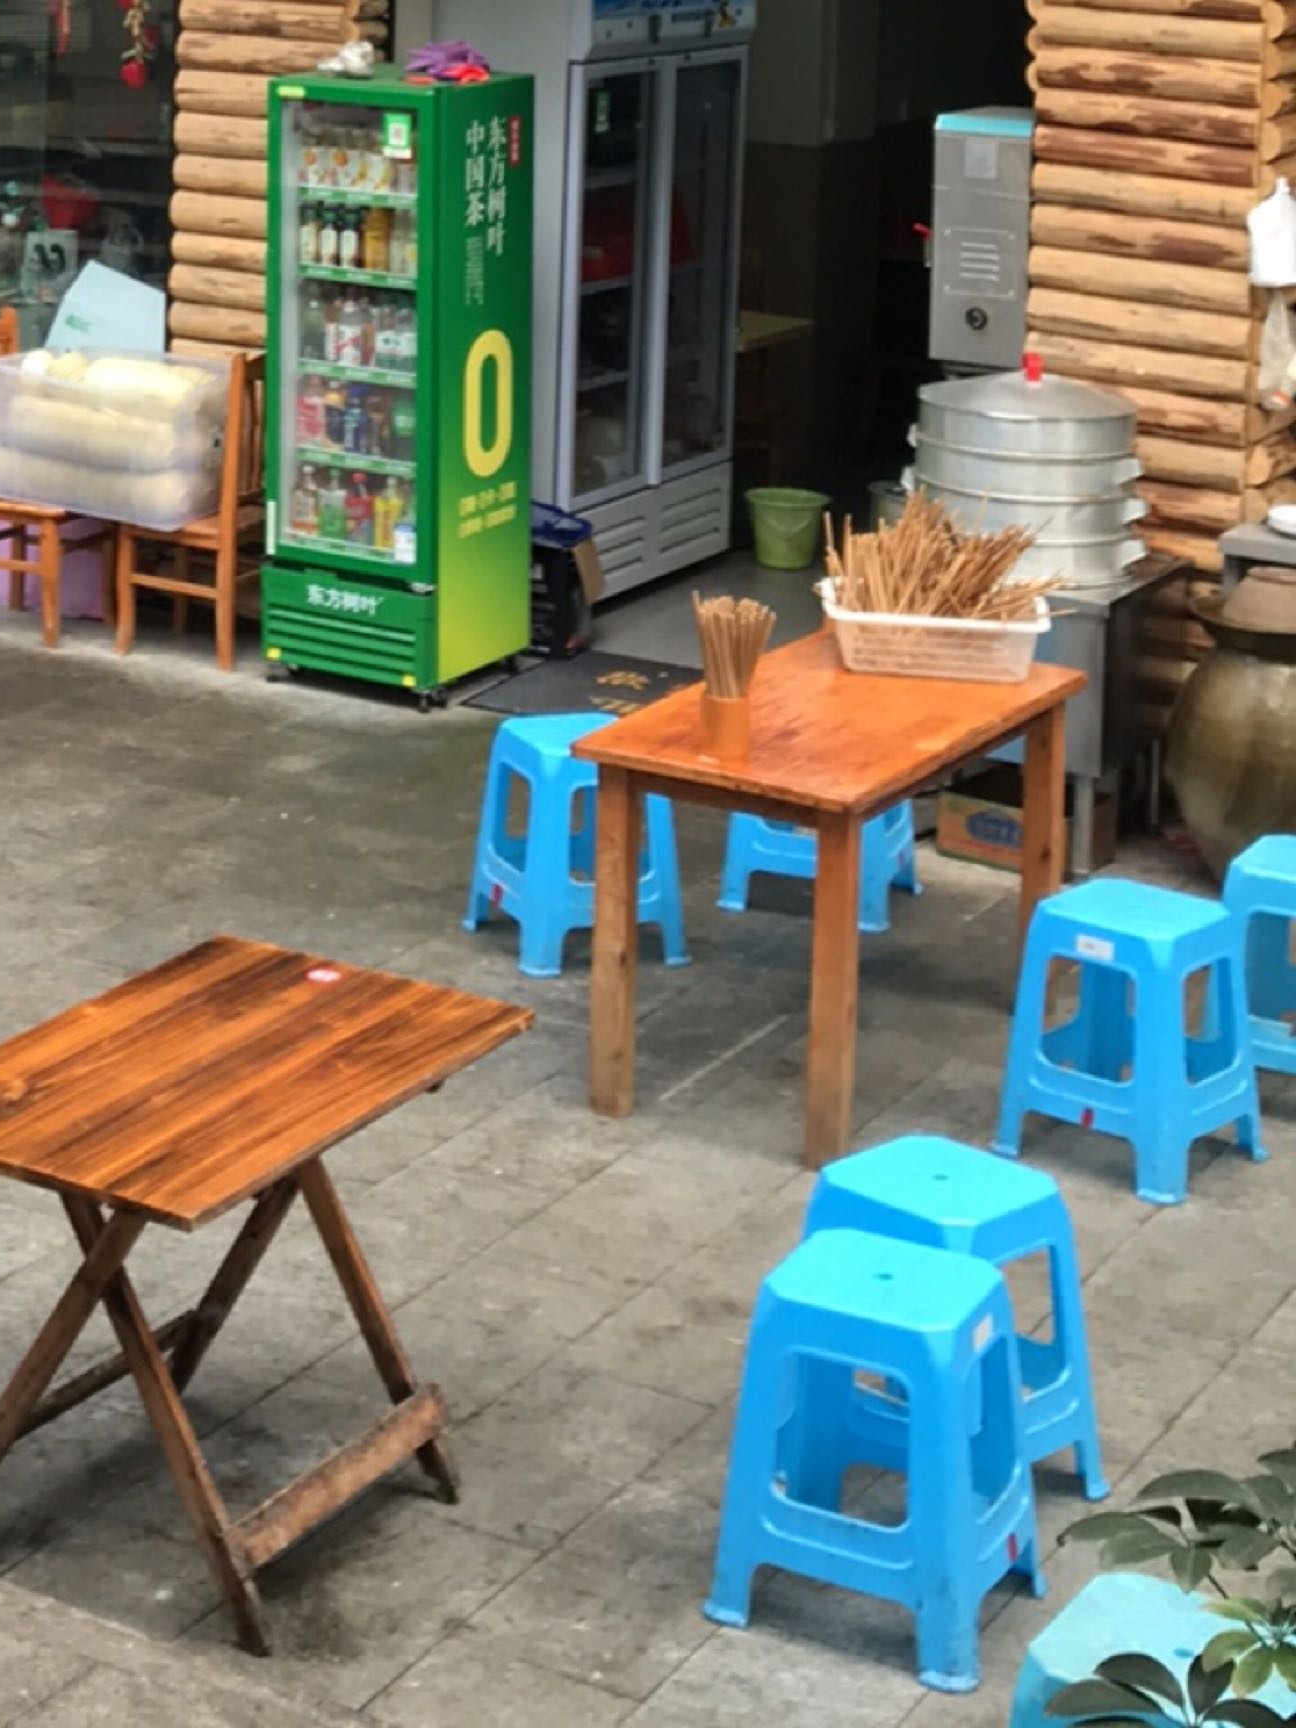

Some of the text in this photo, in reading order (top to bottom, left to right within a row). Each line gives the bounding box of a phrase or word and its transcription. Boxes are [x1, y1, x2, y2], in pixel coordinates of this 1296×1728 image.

[464, 119, 486, 227] 中国茶
[486, 116, 507, 256] 东方树叶
[306, 584, 384, 617] 东方树叶
